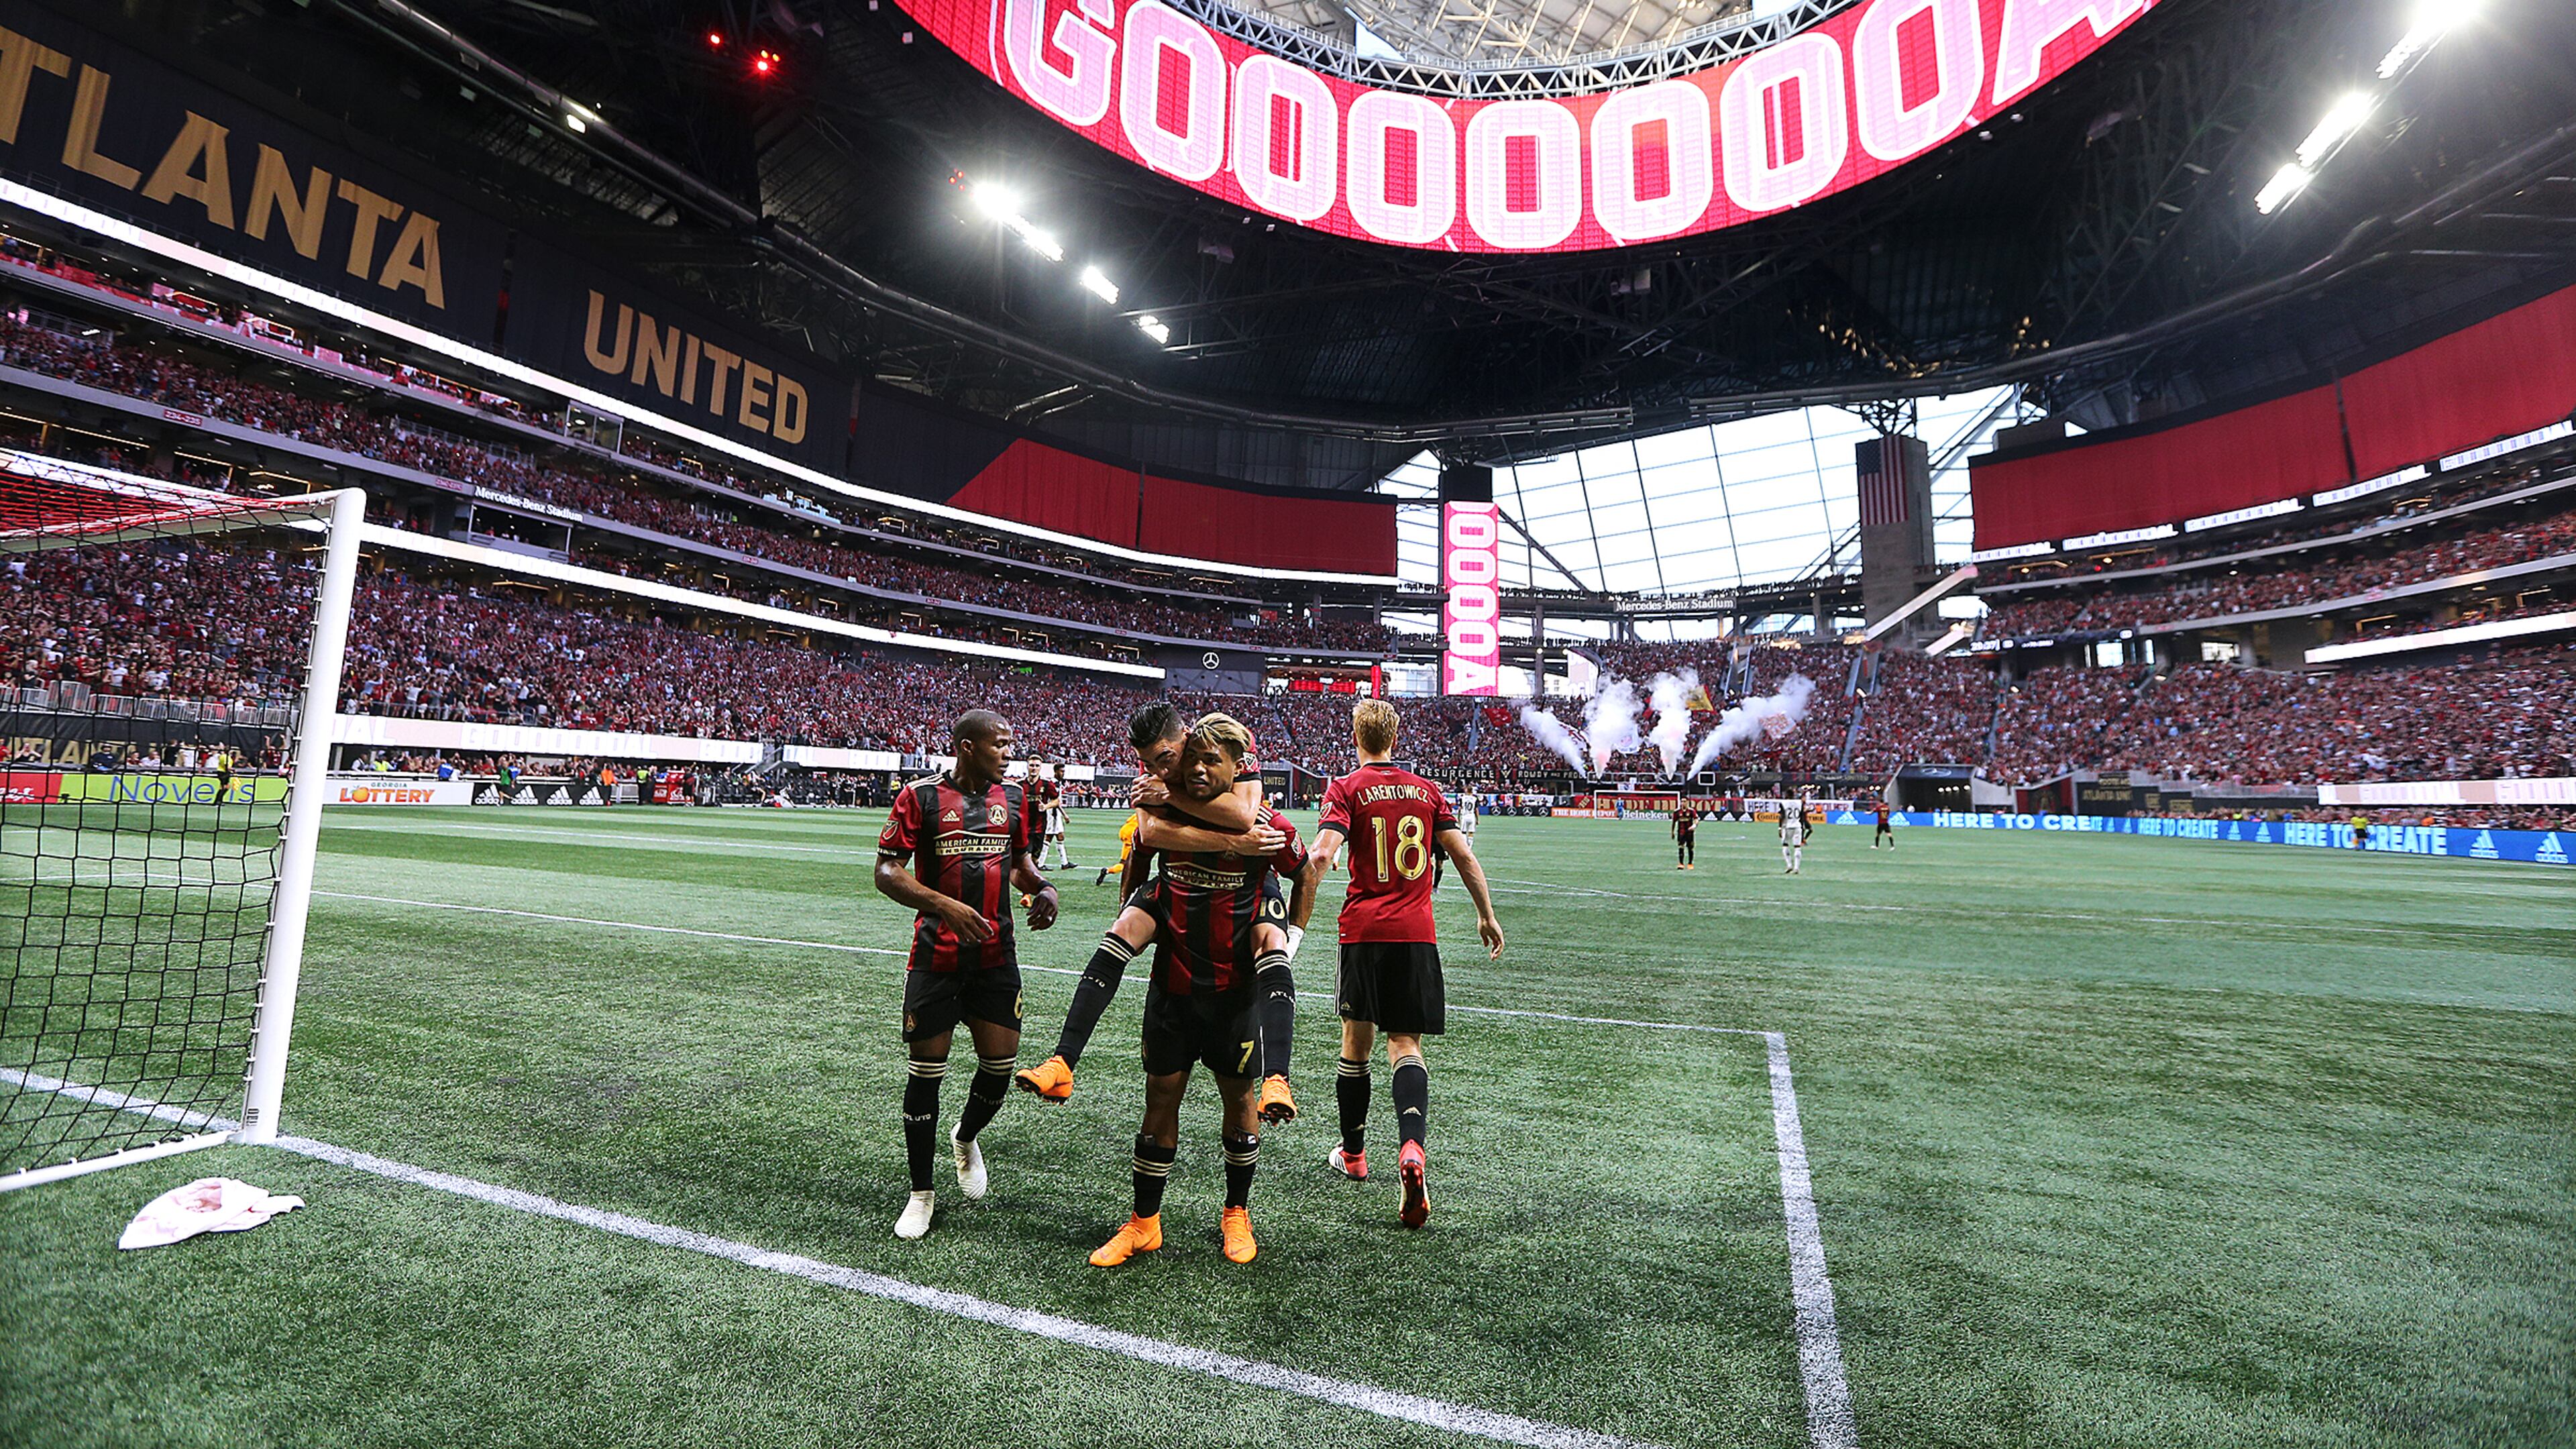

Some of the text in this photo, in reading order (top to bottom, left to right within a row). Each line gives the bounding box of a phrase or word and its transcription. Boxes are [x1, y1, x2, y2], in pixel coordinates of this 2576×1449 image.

[584, 289, 808, 444] UNITED
[475, 486, 584, 523] Mercedes-Benz Stadium
[1616, 598, 1734, 611] Mercedes-Benz Stadium
[1264, 775, 1285, 786] UNITED
[1419, 769, 1495, 778] RESURGENCE
[109, 775, 255, 804] Noveis
[1358, 784, 1430, 806] LARENTOWICZ
[1464, 802, 1473, 811] 10
[1623, 810, 1669, 820] Heineken
[1786, 808, 1801, 820] 20
[1933, 812, 1995, 828] HERE
[2001, 814, 2035, 830] TO
[2137, 817, 2218, 840] HERE TO CREATE
[936, 839, 1009, 847] AMERICAN FAMILY
[2284, 822, 2448, 856] HERE TO CREATE
[940, 847, 1004, 855] INSURANCE
[1371, 815, 1428, 882] 18
[1212, 874, 1245, 883] FAMILY
[1259, 897, 1285, 920] 10
[1237, 1040, 1255, 1074] 7
